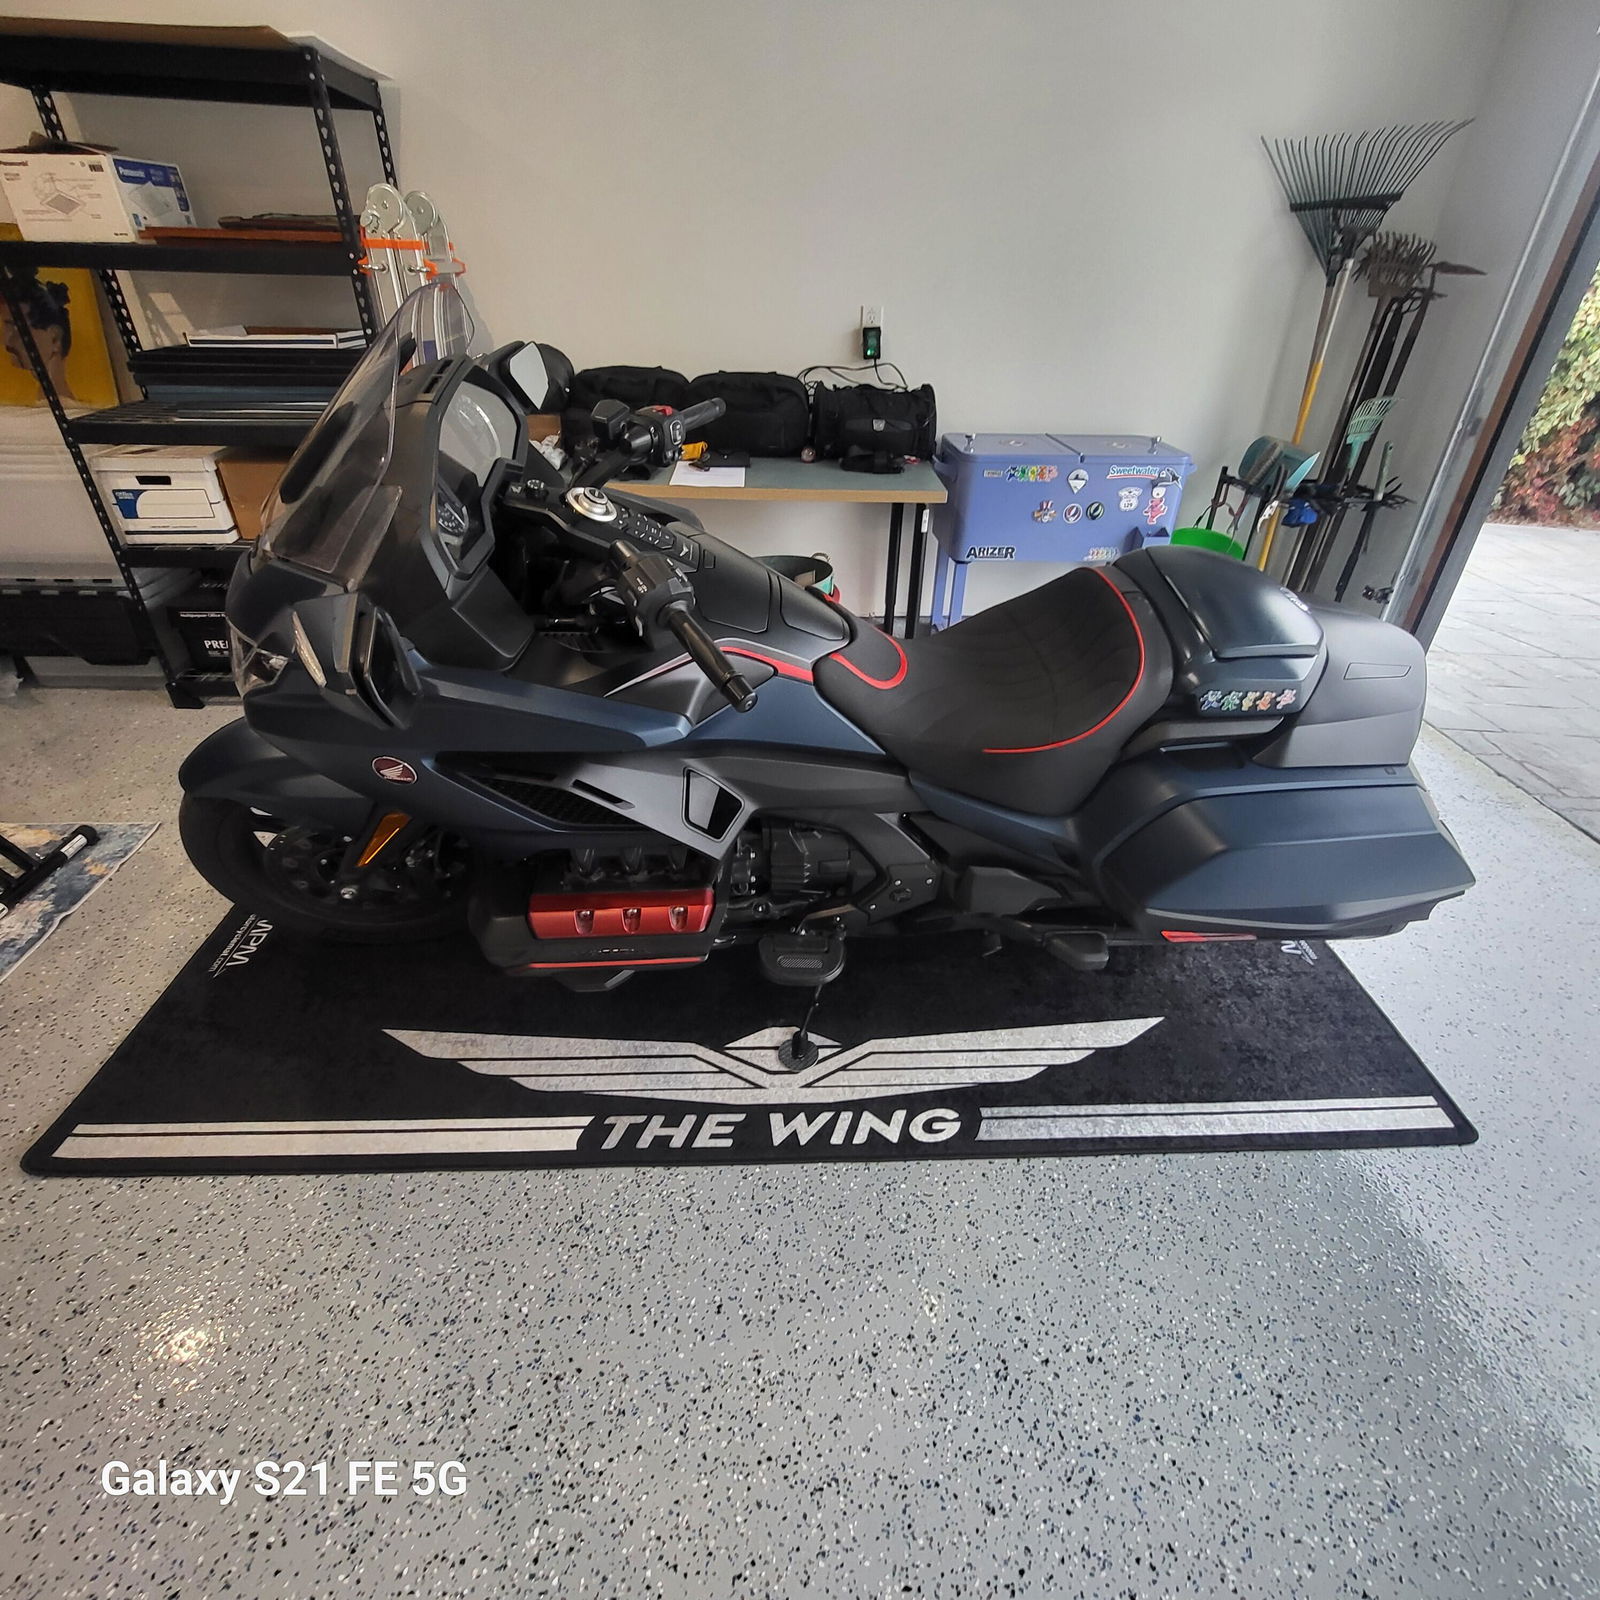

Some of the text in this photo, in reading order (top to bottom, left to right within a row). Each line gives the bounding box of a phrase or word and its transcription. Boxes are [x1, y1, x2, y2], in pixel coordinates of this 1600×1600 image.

[1109, 465, 1158, 476] Sweetwater
[966, 546, 1015, 559] ARIZER
[601, 1108, 962, 1150] THE WING
